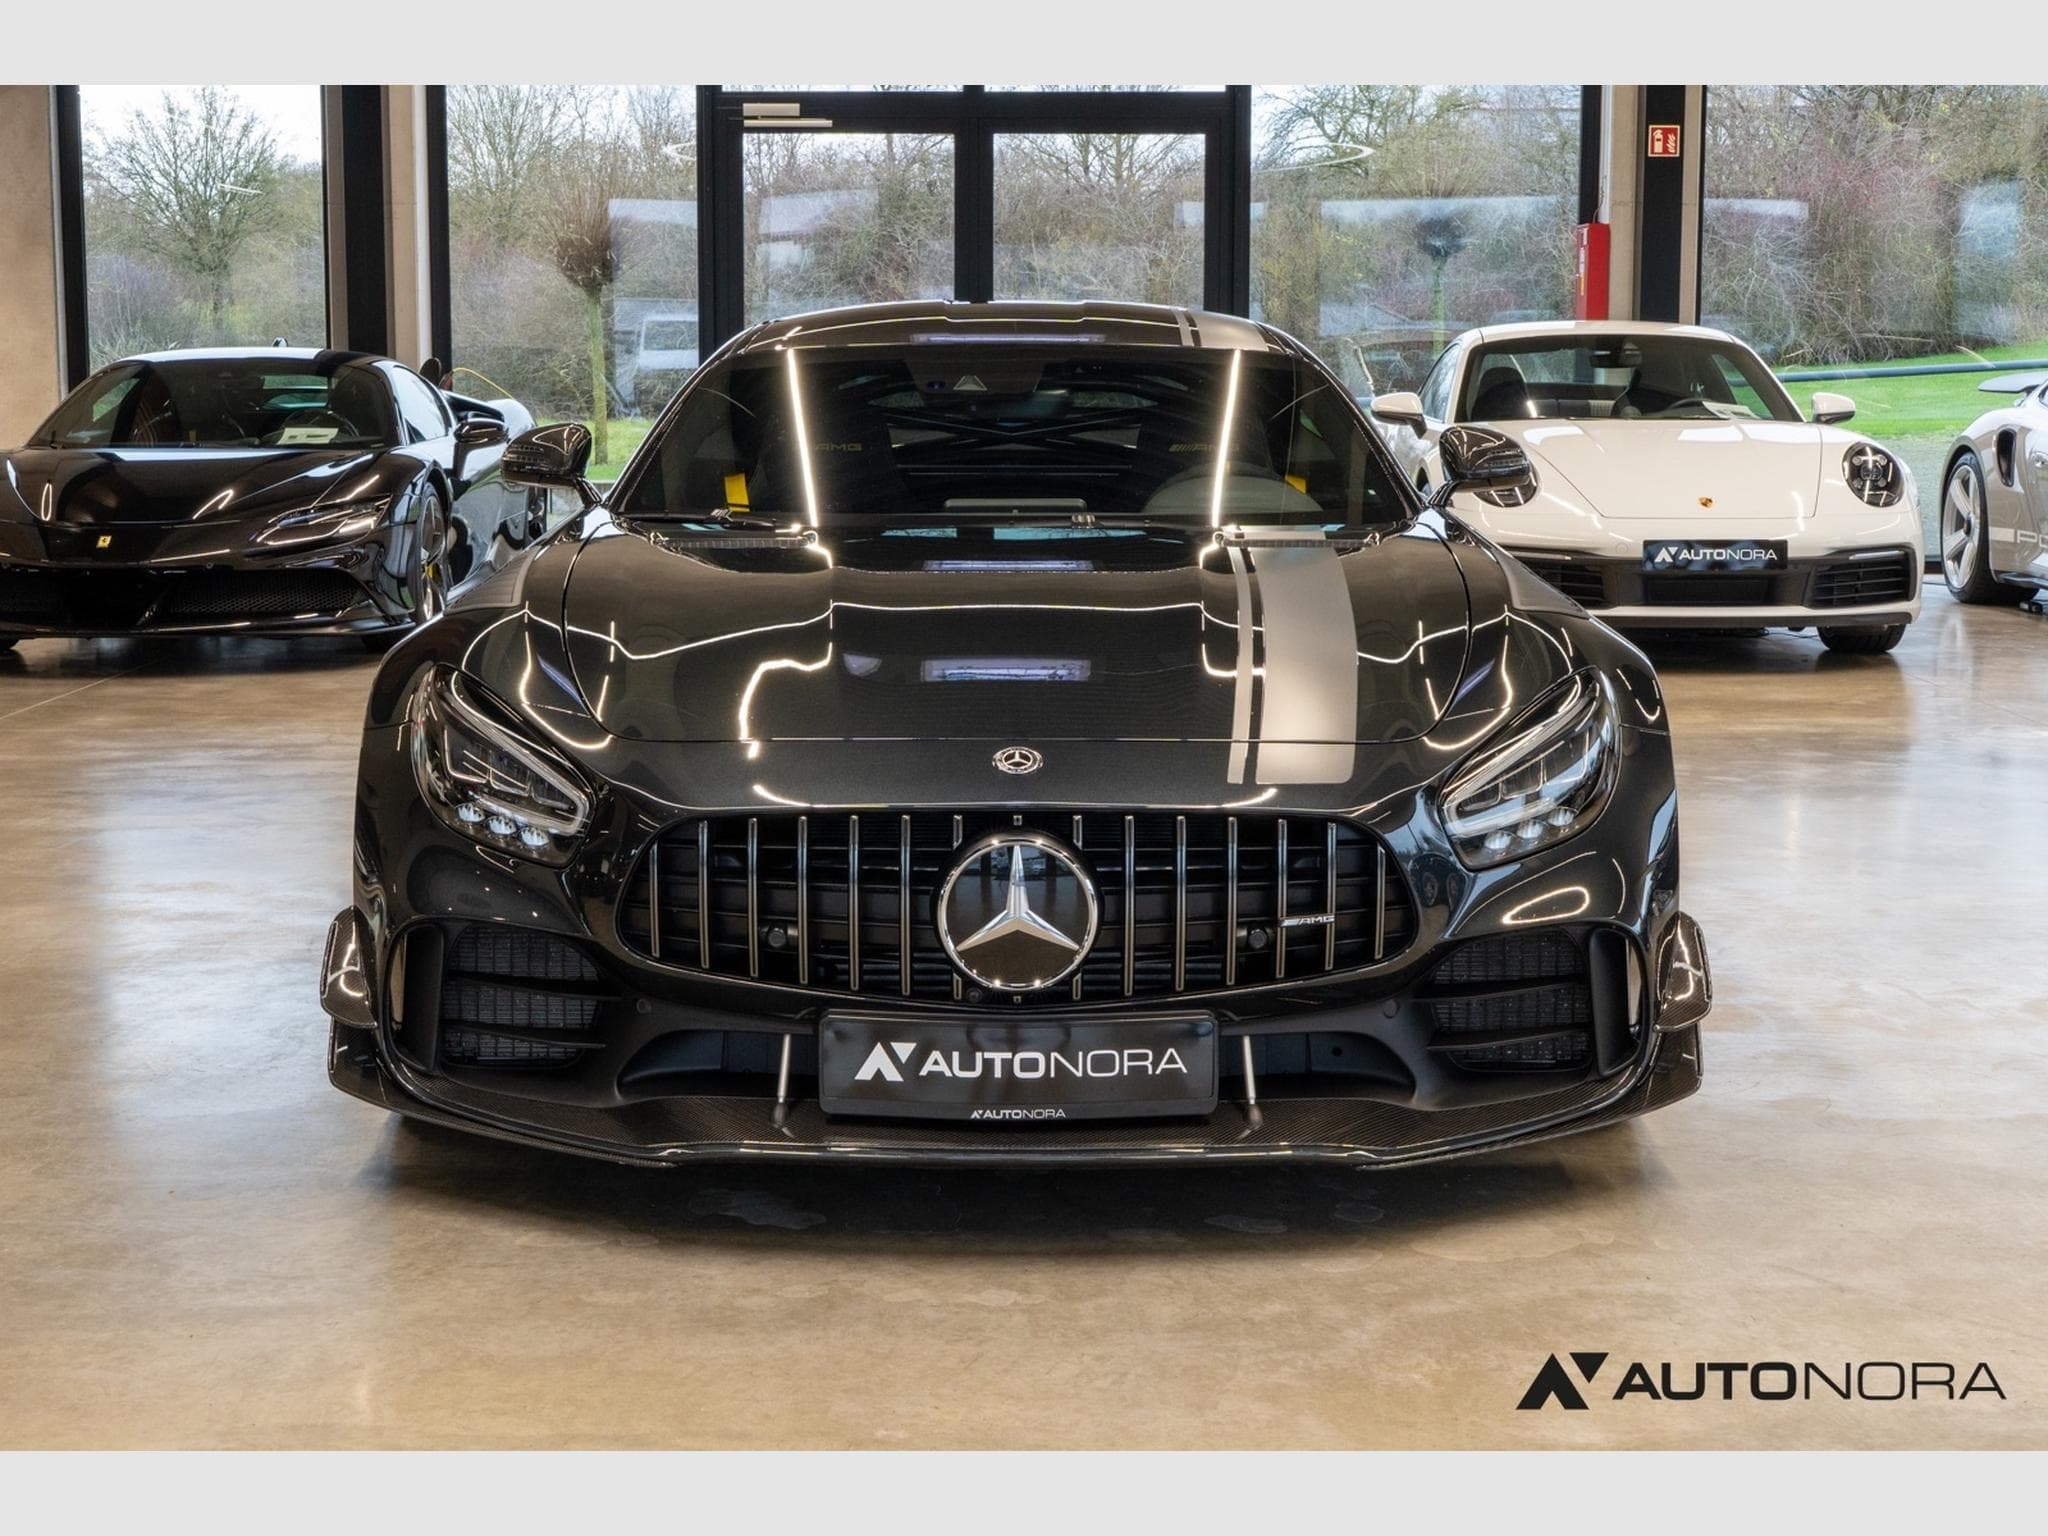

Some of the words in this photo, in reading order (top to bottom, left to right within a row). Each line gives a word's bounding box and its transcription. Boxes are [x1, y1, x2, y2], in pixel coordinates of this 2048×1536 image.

[1678, 548, 1778, 561] AUTONORA
[1298, 915, 1335, 926] AMG
[918, 1047, 1188, 1079] AUTONORA
[982, 1108, 1067, 1120] AUTONORA
